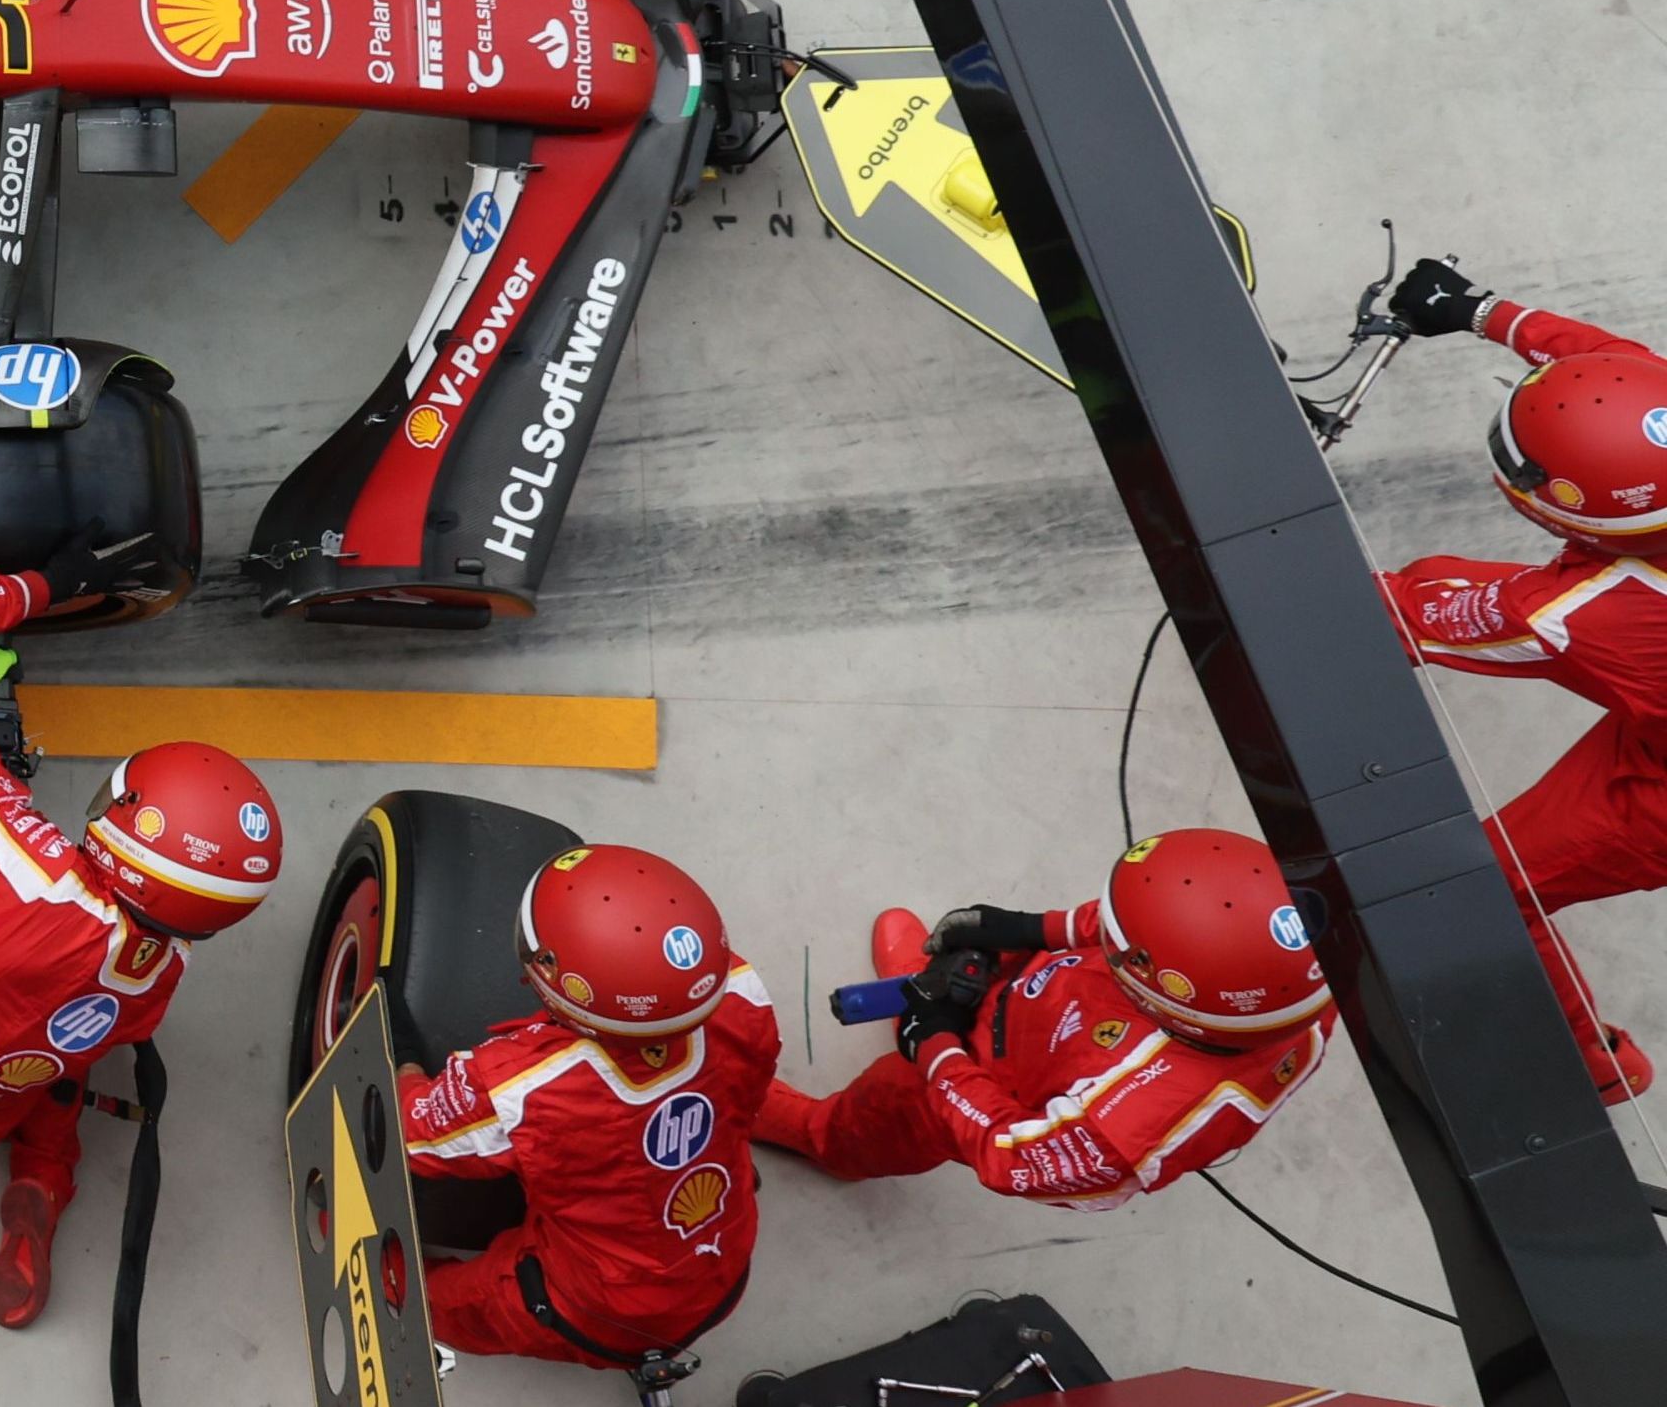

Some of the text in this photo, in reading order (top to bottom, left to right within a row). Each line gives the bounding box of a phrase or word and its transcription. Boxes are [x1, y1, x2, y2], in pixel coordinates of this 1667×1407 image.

[859, 96, 930, 180] brembo
[380, 199, 404, 223] 5
[770, 214, 795, 239] 2
[429, 258, 536, 409] V-Power
[1611, 483, 1656, 500] PERONI
[183, 833, 220, 854] PERONI
[668, 928, 699, 968] hp
[617, 995, 658, 1005] PERONI
[1220, 988, 1267, 1001] PERONI
[56, 996, 114, 1050] hp
[653, 1096, 705, 1168] hp
